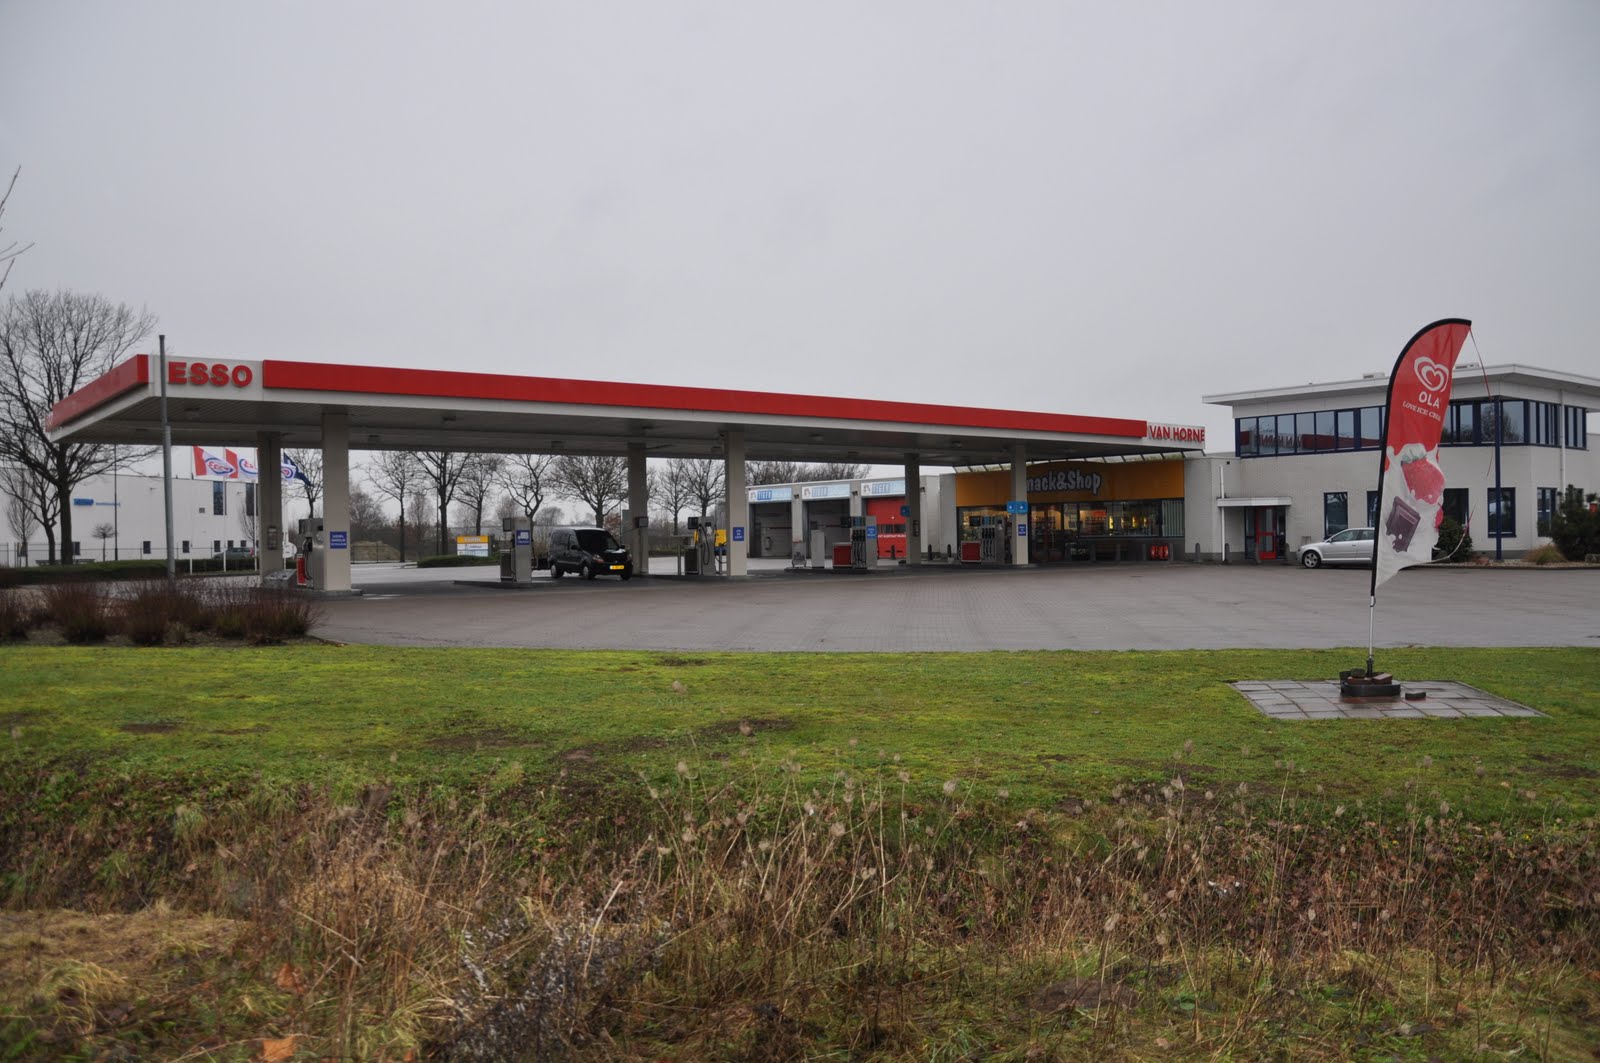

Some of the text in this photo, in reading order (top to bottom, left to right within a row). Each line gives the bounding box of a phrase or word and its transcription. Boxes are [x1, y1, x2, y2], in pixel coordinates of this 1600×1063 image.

[168, 361, 253, 388] ESSO
[1419, 391, 1440, 408] OLA
[1149, 425, 1205, 442] VAN HORNE
[1026, 469, 1101, 495] nack&Shop
